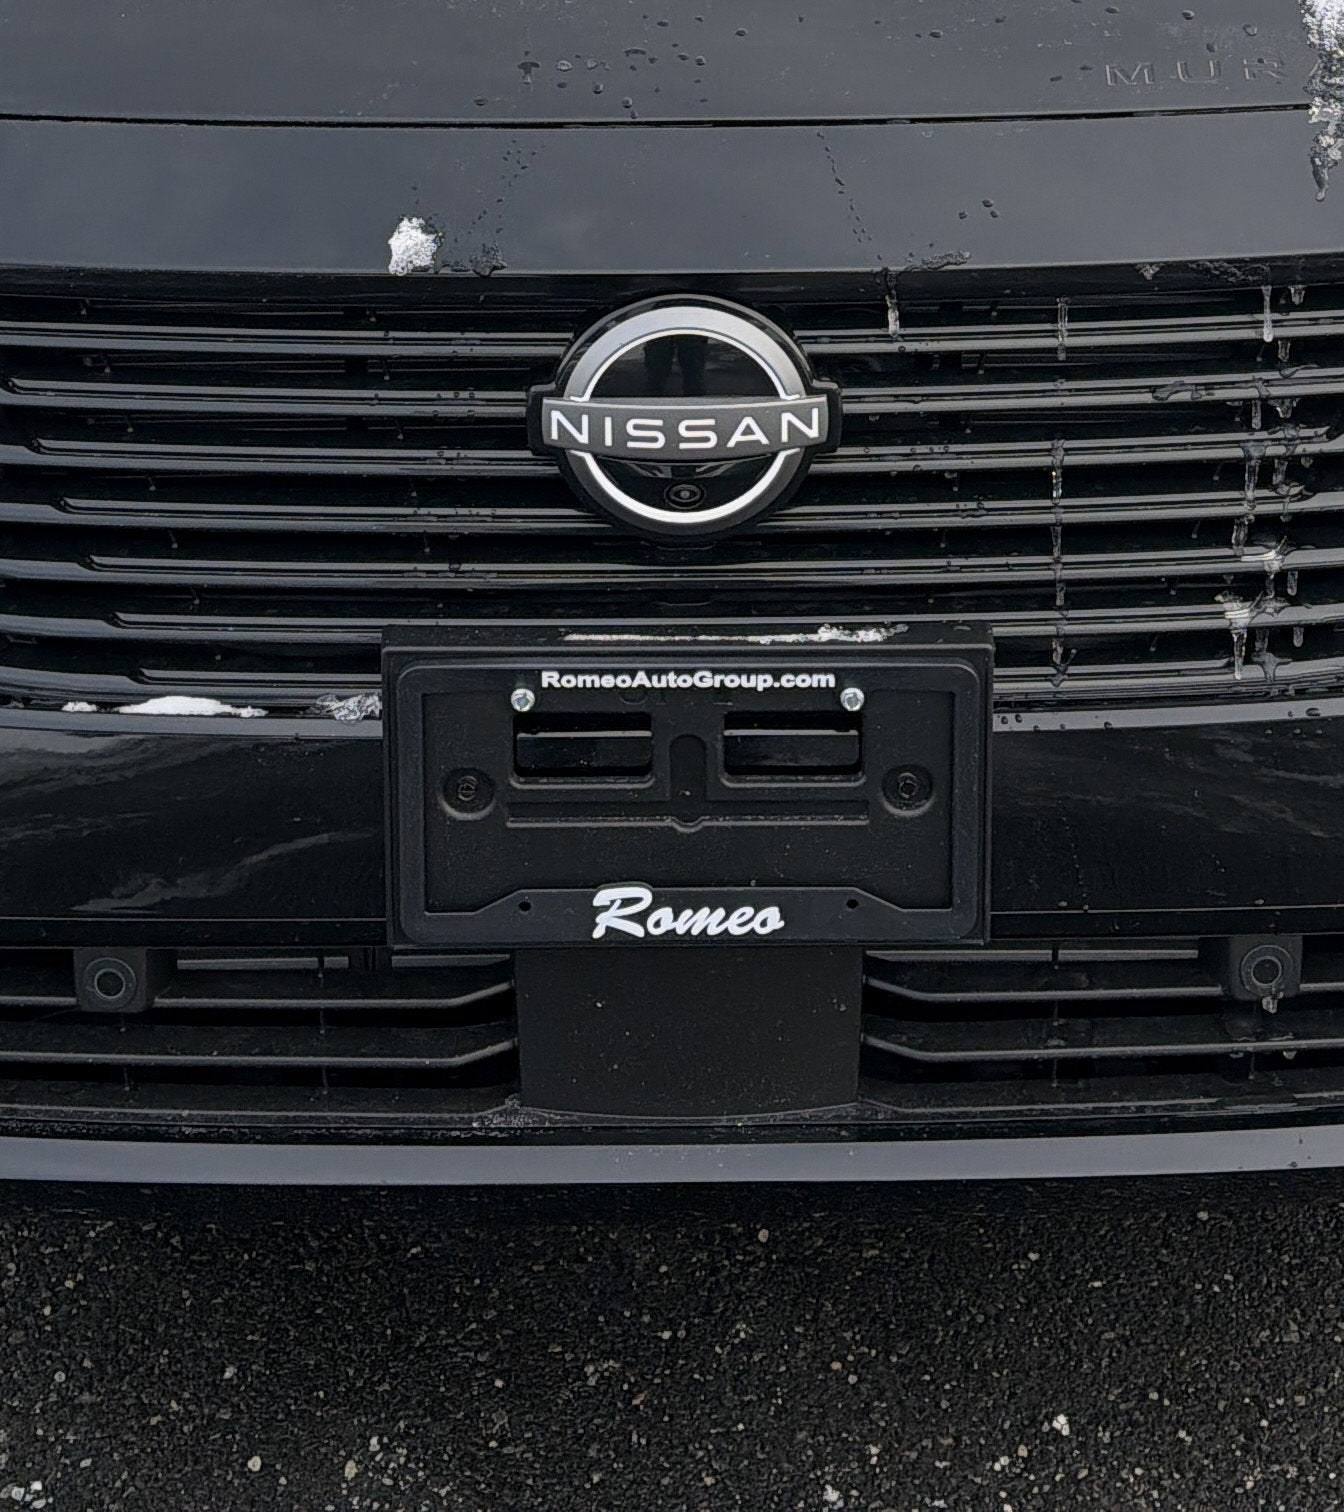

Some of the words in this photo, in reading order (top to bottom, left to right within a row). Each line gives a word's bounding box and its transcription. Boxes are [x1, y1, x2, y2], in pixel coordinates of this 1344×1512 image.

[550, 407, 819, 450] NISSAN
[541, 670, 835, 691] RomeoAutoGroup.com
[592, 886, 785, 939] Romeo
